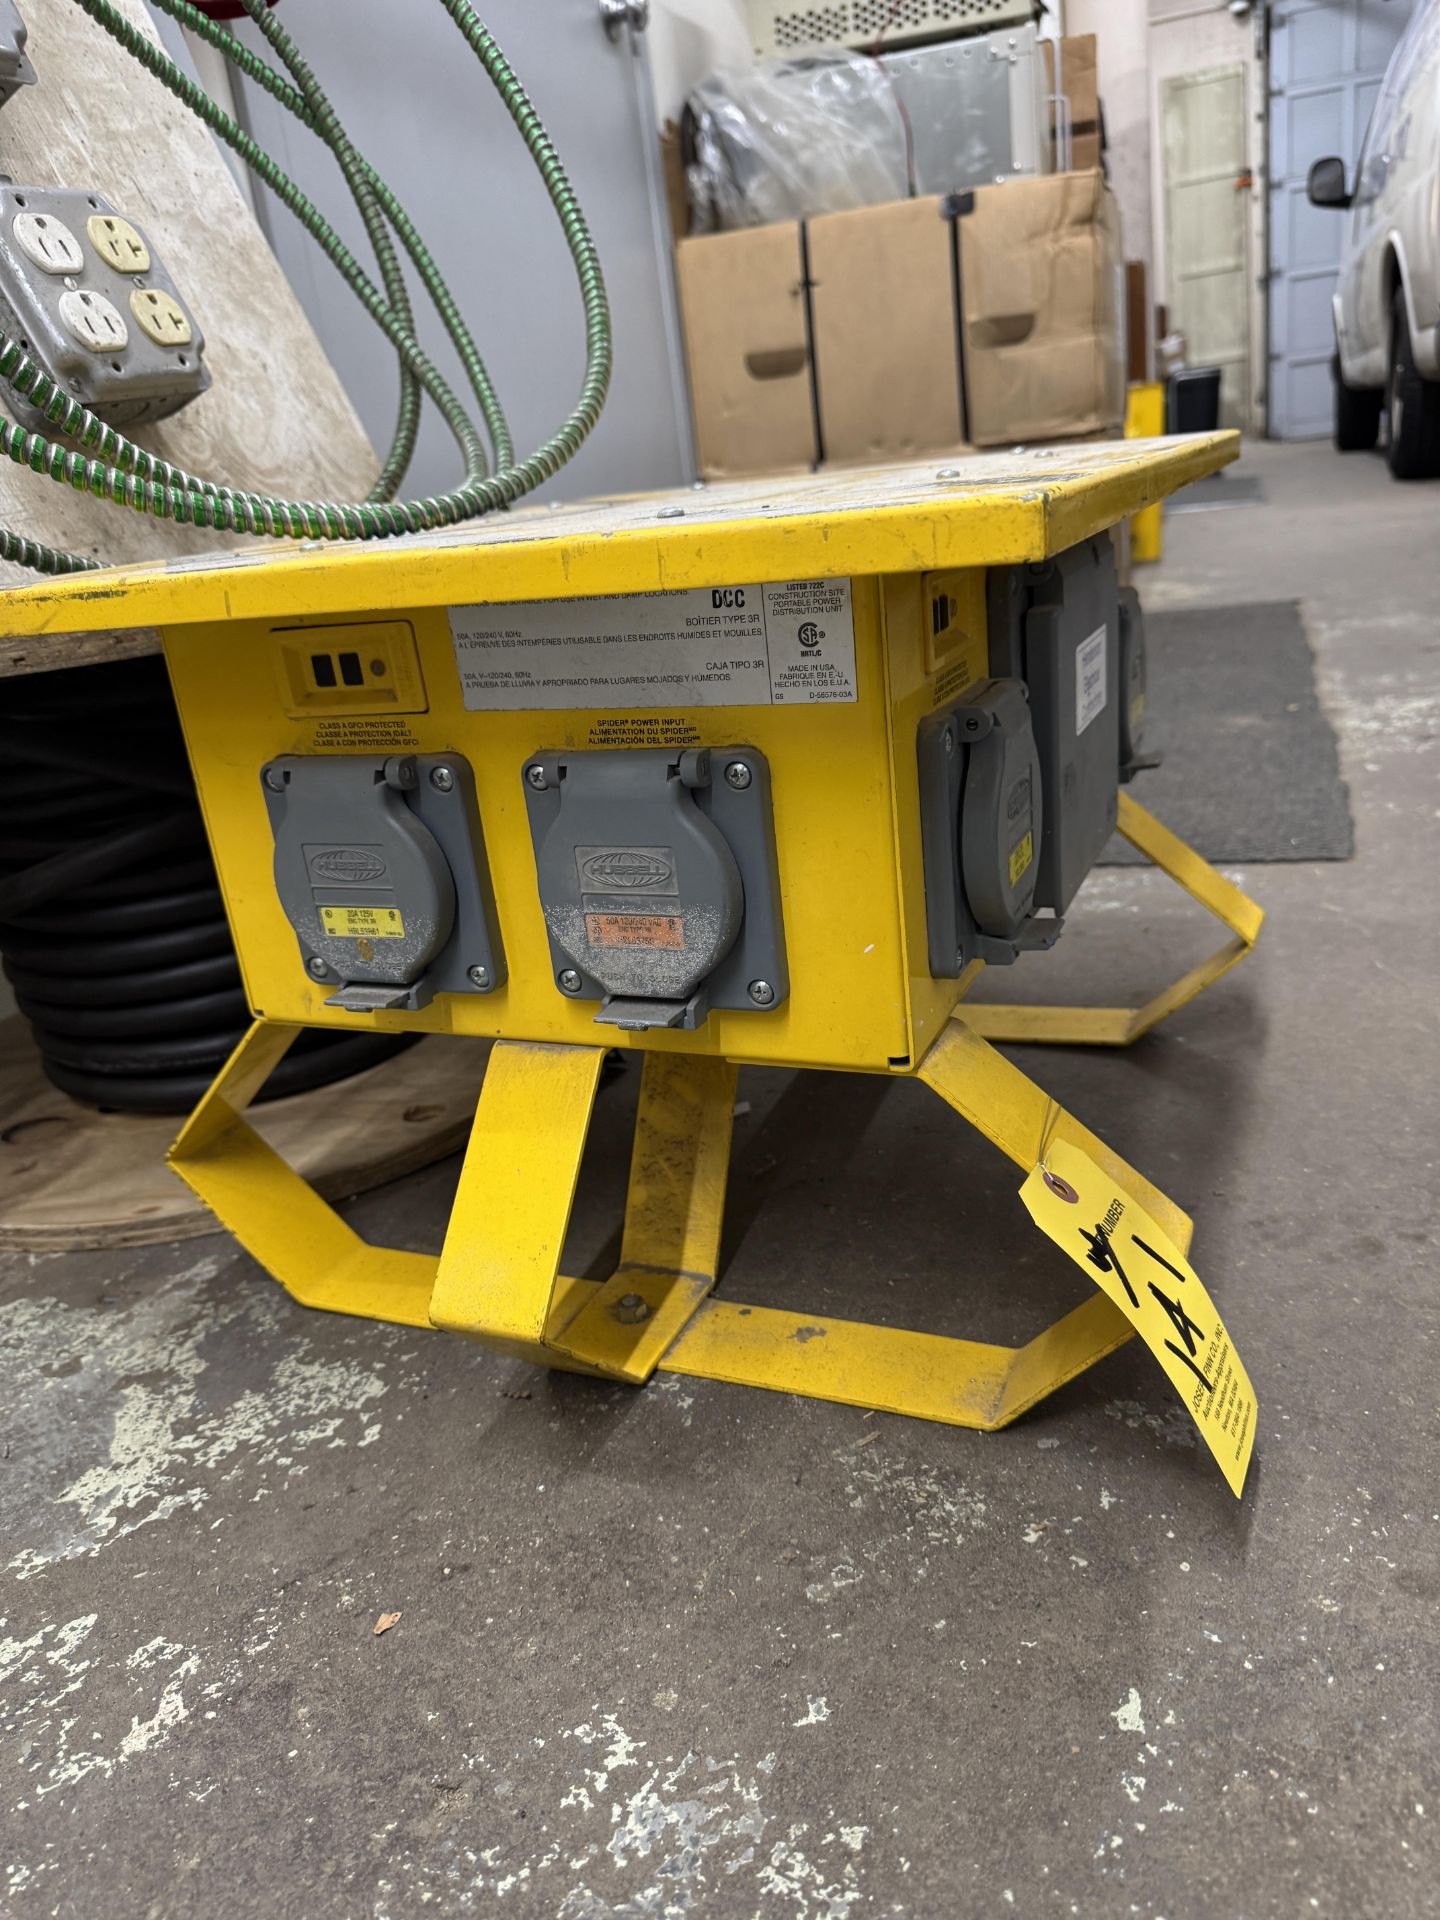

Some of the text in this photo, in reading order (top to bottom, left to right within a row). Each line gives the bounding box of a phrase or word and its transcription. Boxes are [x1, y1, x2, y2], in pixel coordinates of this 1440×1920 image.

[786, 583, 807, 591] LISTED
[768, 589, 845, 600] CONSTRUCTION SITE
[773, 598, 841, 608] PORTABLE POWER
[772, 605, 844, 616] DISTRIBUTION UNIT
[722, 614, 746, 624] TYPE
[748, 614, 760, 623] 3R
[502, 640, 516, 648] DES
[602, 635, 623, 643] DANS
[623, 634, 638, 642] LES
[639, 632, 676, 641] ENDROITS
[677, 630, 711, 640] HUMIDES
[712, 630, 722, 638] ET
[706, 660, 764, 671] CAJA TIPO 3R
[788, 664, 809, 672] MADE
[472, 681, 500, 689] PRUEBA
[500, 680, 511, 688] DE
[511, 679, 534, 688] LLUVIA
[542, 678, 589, 687] APROPRIADO
[590, 677, 609, 685] PARA
[610, 676, 646, 684] LUGARES
[646, 675, 683, 684] MOJADOS
[774, 680, 800, 688] HECHO
[814, 679, 829, 687] LOS
[661, 718, 686, 726] INPUT
[349, 730, 392, 738] PROTECTION
[589, 728, 645, 736] ALIMENTATION
[588, 735, 645, 745] ALIMENTACIÓN
[646, 736, 661, 744] DEL
[590, 864, 667, 876] HUBBELL
[1203, 1354, 1214, 1378] FINN
